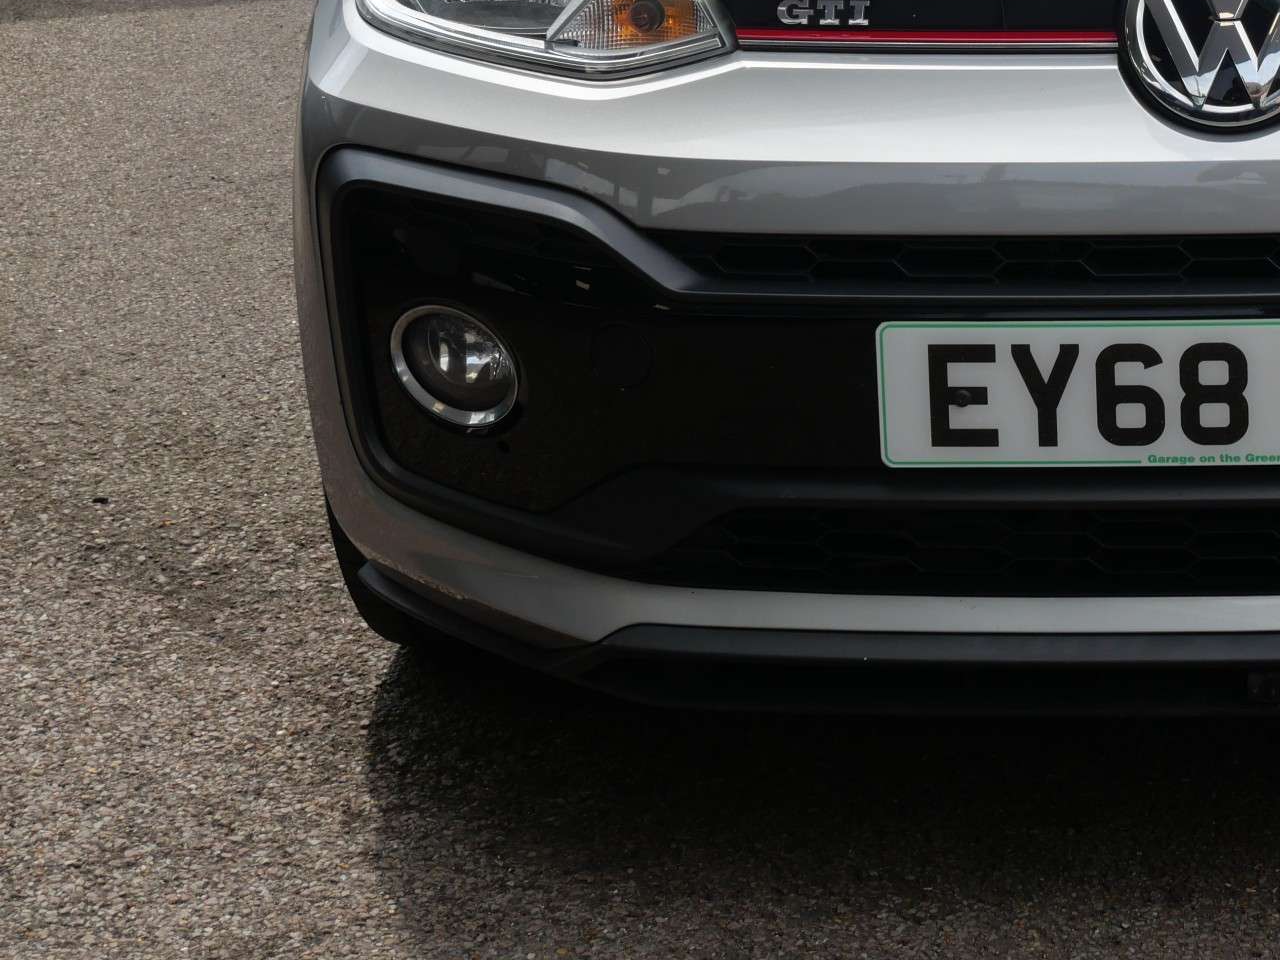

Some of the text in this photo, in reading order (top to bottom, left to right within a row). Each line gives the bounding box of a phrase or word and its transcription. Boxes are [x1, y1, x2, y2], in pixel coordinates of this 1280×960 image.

[927, 342, 1250, 448] EY68
[1147, 454, 1196, 465] Garage
[1199, 455, 1216, 464] on
[1219, 454, 1242, 464] the
